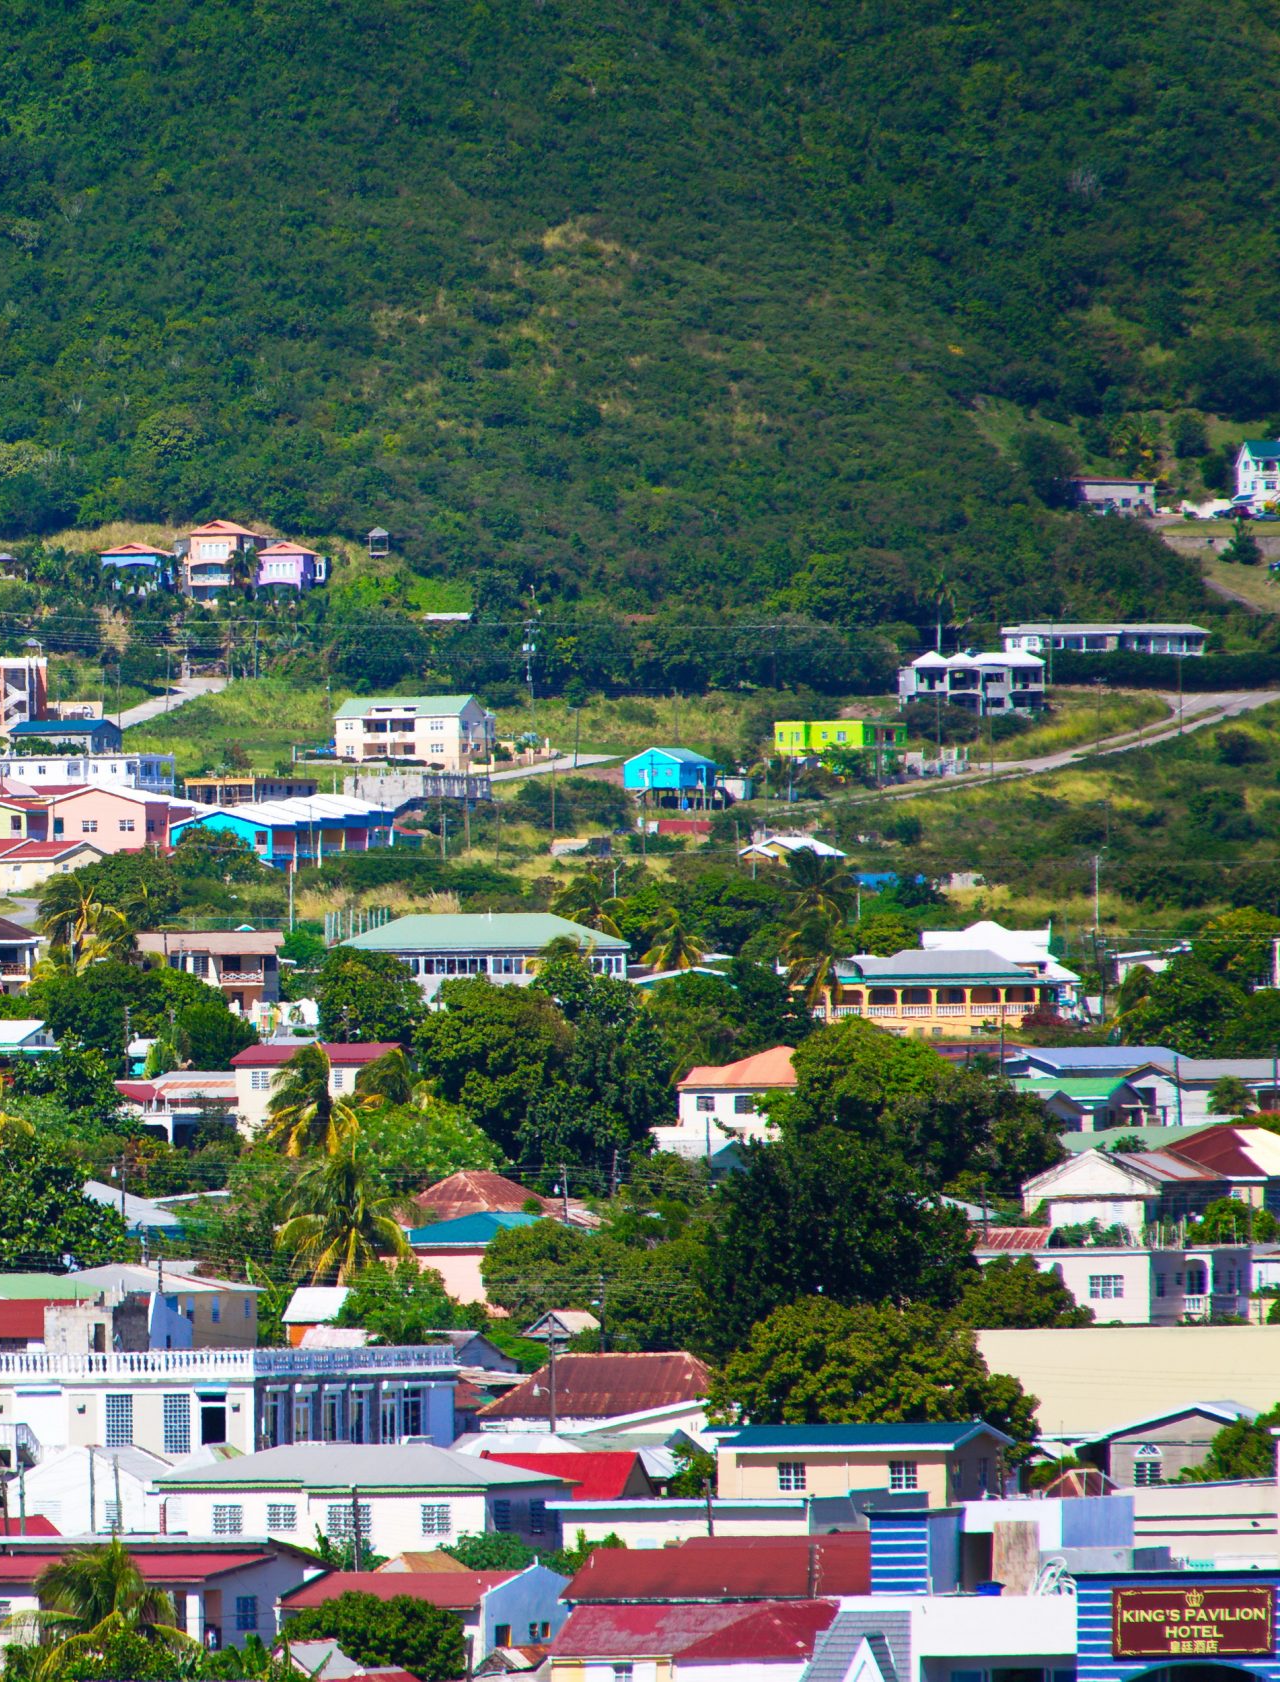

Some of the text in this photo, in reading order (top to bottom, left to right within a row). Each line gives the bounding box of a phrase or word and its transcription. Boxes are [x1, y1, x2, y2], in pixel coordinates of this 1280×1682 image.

[1123, 1608, 1266, 1622] KING'S PAVILION
[1165, 1625, 1224, 1638] HOTEL
